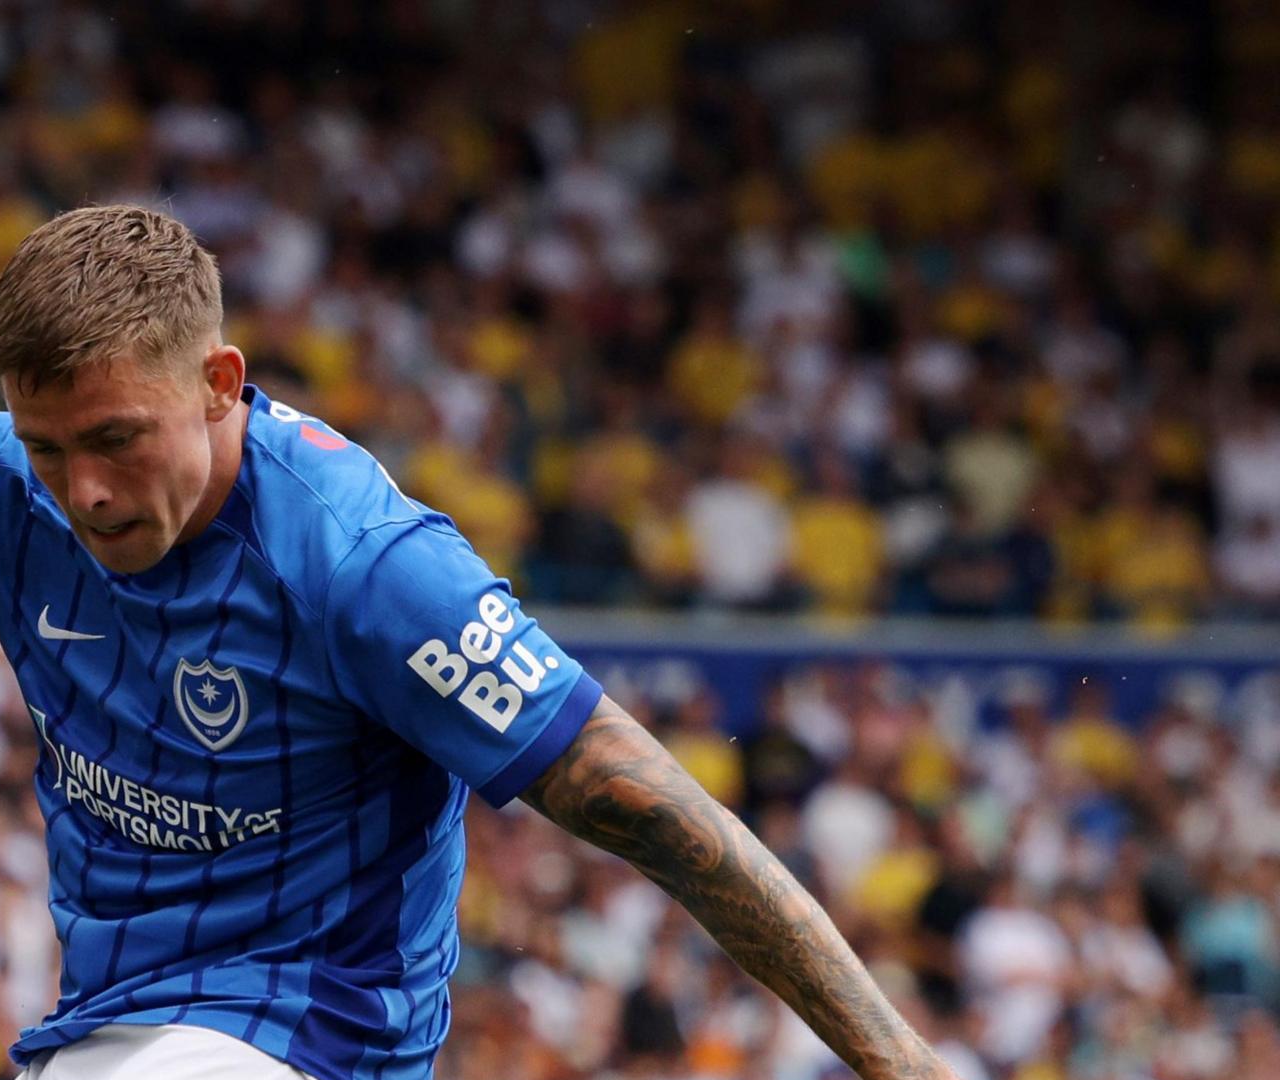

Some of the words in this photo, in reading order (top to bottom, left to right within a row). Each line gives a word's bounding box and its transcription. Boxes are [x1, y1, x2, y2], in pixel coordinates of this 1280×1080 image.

[406, 593, 515, 698] Bee
[457, 641, 559, 734] Bu.
[60, 743, 242, 834] UNIVERSITY
